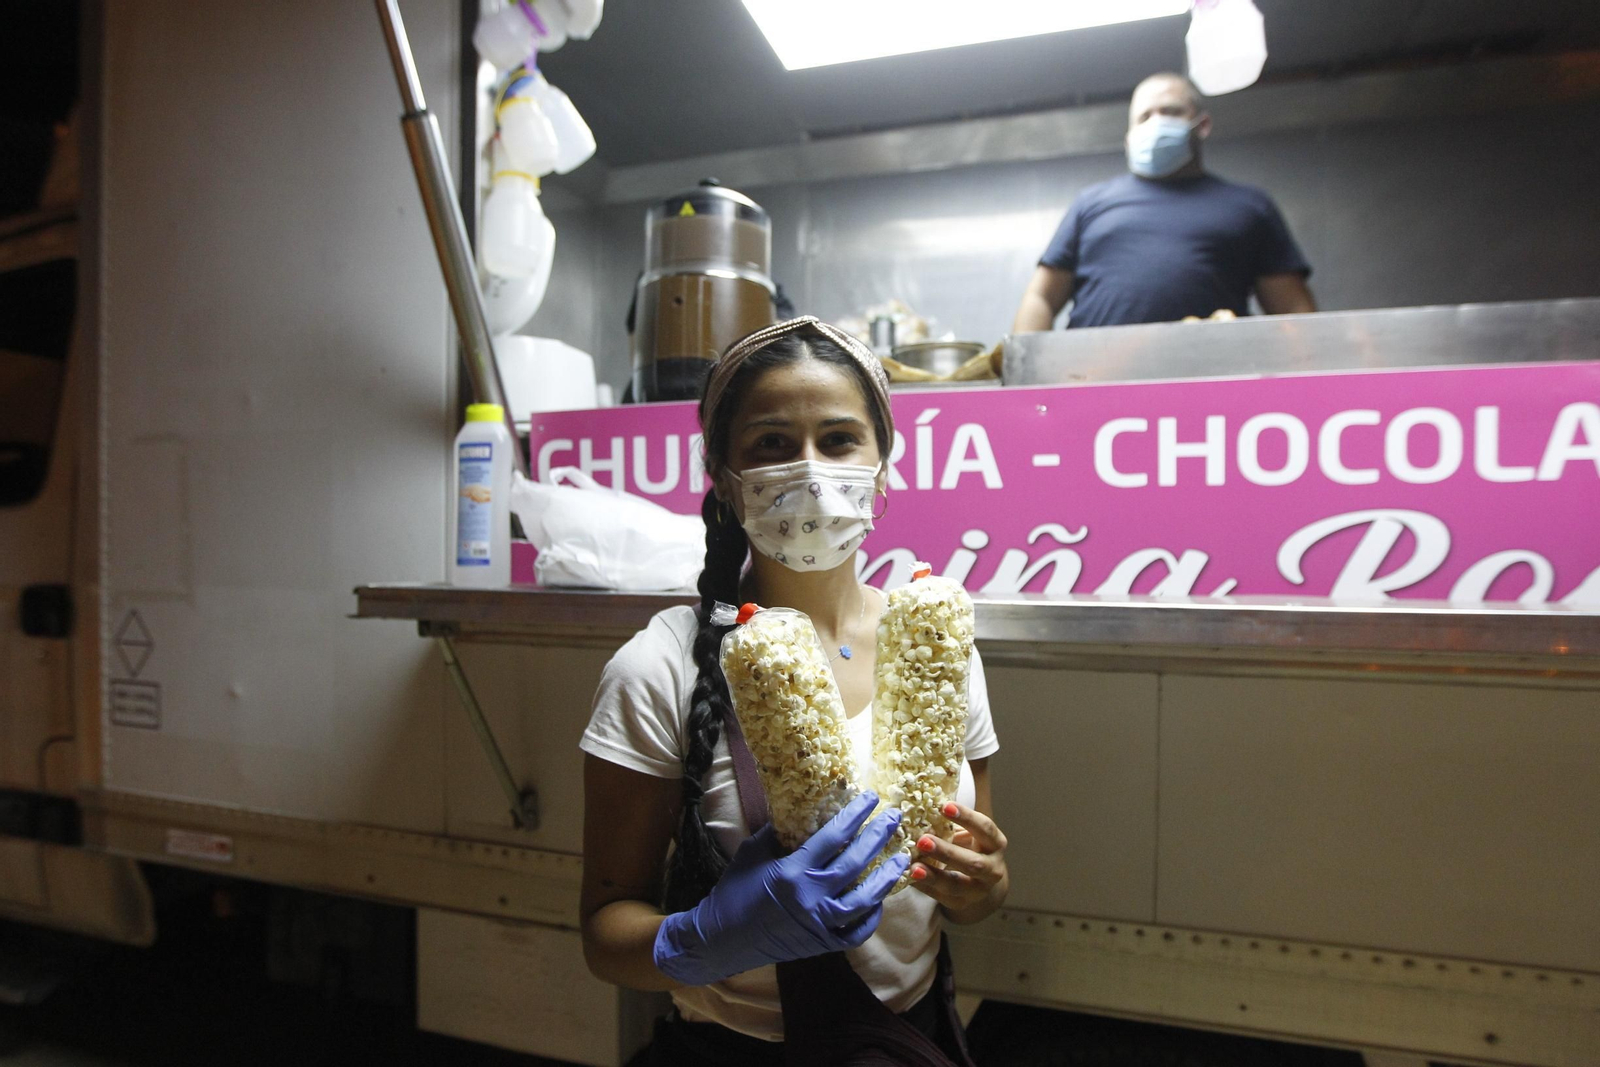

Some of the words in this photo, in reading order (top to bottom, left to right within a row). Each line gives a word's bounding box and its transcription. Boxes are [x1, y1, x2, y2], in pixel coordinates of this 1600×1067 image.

[537, 408, 1004, 496] CHURÍA
[1032, 454, 1061, 467] -
[1093, 402, 1600, 489] CHOCOLA
[1276, 508, 1600, 602] Ro
